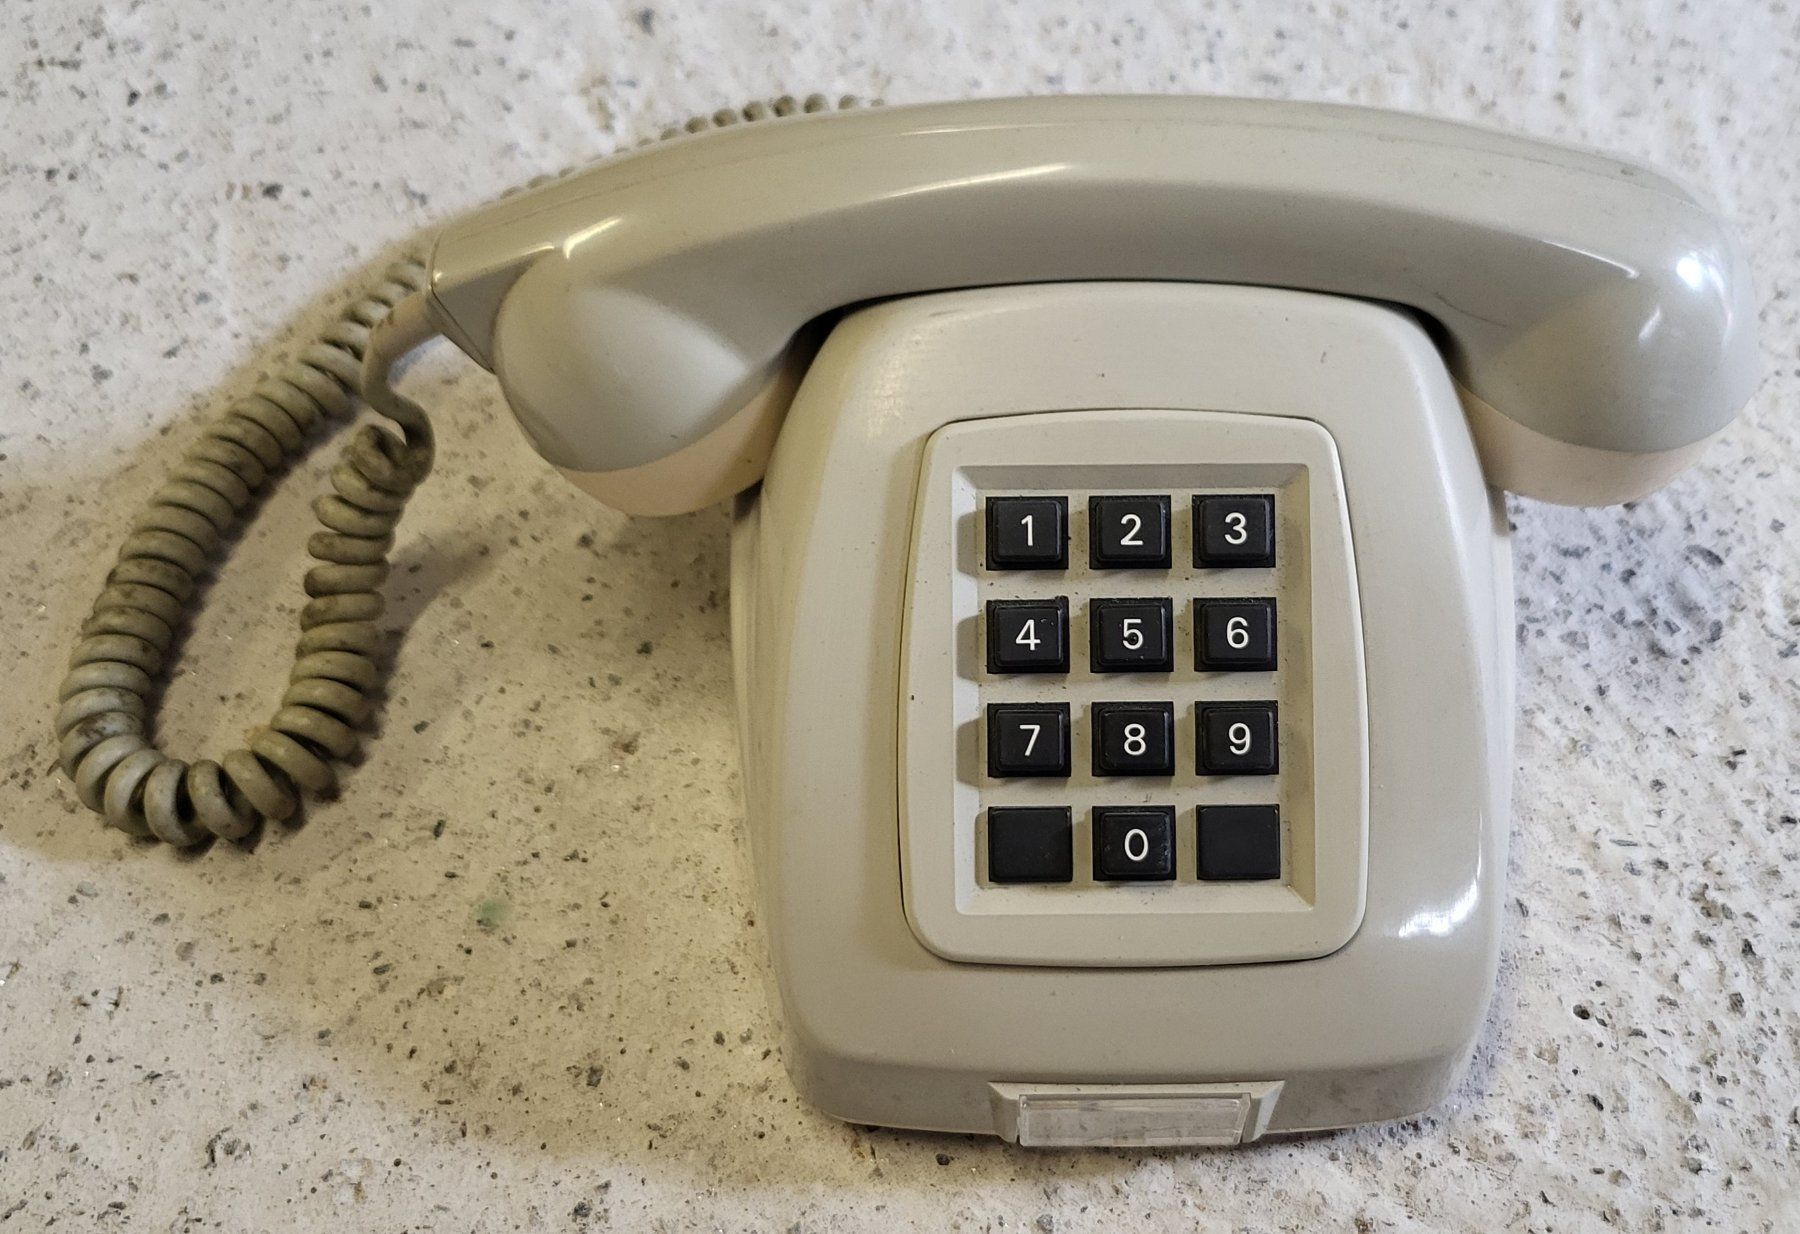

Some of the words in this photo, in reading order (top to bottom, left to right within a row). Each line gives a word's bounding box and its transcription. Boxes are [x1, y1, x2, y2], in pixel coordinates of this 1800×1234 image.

[1021, 514, 1034, 547] 1
[1120, 513, 1144, 546] 2
[1224, 512, 1248, 545] 3
[1015, 619, 1041, 651] 4
[1122, 618, 1144, 650] 5
[1226, 616, 1249, 649] 6
[1019, 724, 1041, 756] 7
[1123, 723, 1147, 756] 8
[1228, 722, 1251, 755] 9
[1124, 828, 1149, 861] 0
